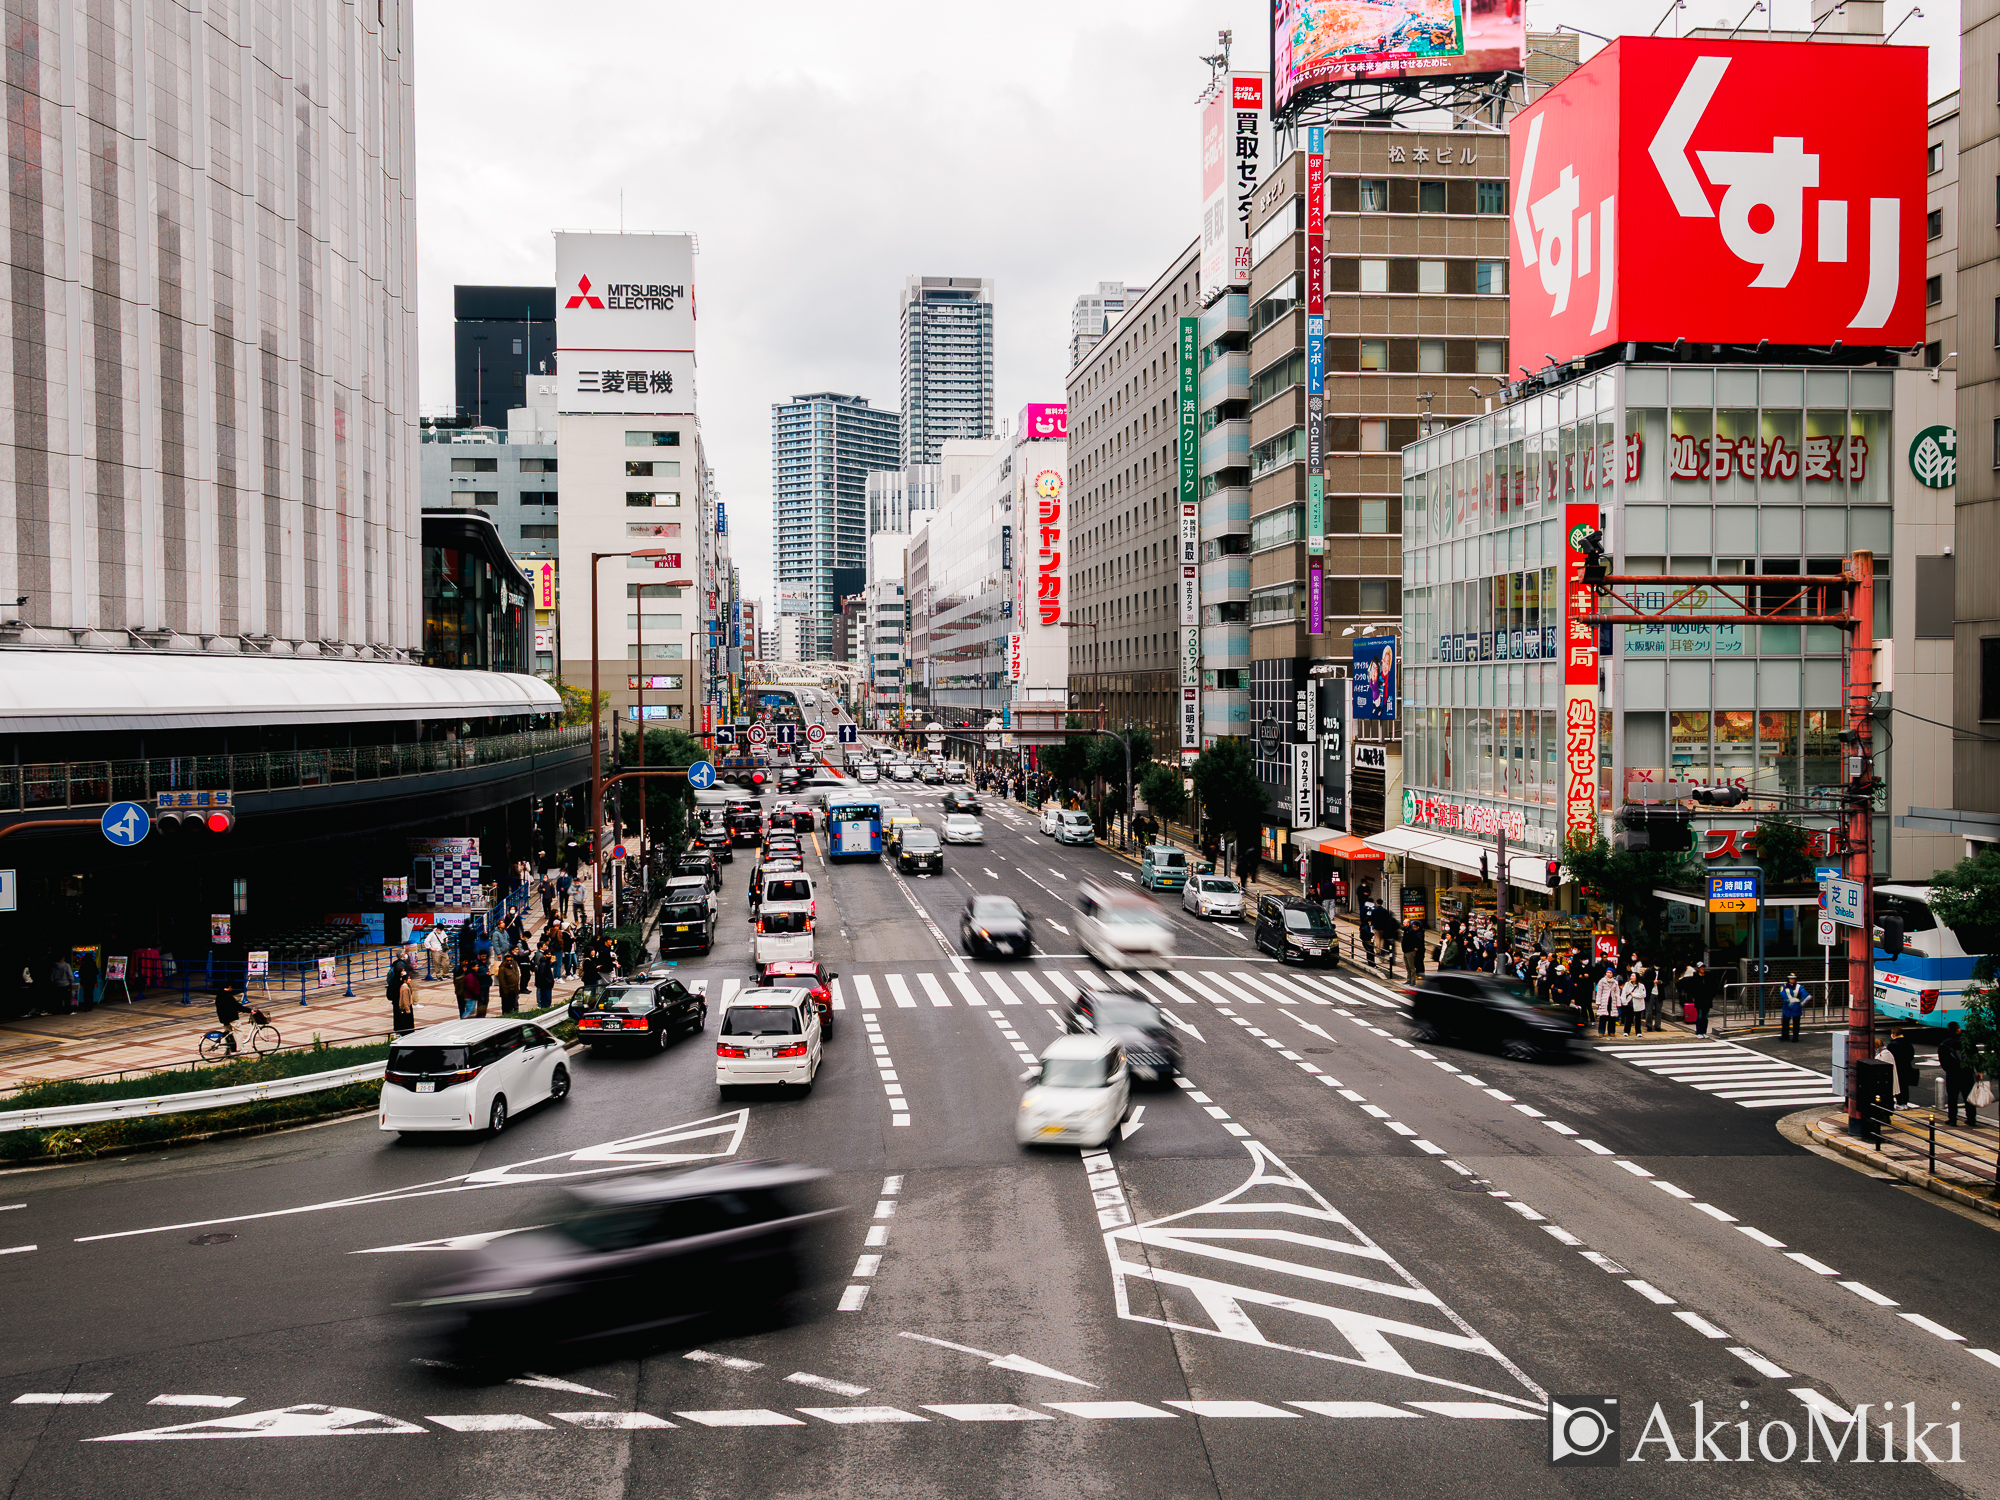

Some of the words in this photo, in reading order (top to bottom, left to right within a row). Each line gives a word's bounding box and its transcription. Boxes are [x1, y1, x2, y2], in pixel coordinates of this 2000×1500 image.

[1234, 92, 1261, 101] キタムラ
[1389, 145, 1477, 165] 松本ビル
[1236, 112, 1259, 240] 買取センター
[1648, 56, 1901, 329] くすり
[1260, 177, 1284, 213] 松本ビル
[1311, 170, 1321, 227] ボディスパ
[1203, 196, 1225, 252] 買取
[1513, 110, 1615, 337] くすり
[607, 284, 684, 298] MITSUBISHI
[1311, 245, 1321, 303] ヘッドスパ
[608, 297, 674, 310] ELECTRIC
[1184, 326, 1193, 360] 形成外科
[577, 370, 674, 394] 三菱電機
[1310, 340, 1322, 391] ラポート
[1182, 400, 1196, 493] 浜口クリニック
[1311, 412, 1322, 466] Z-CLINIC
[1670, 434, 1868, 482] 処方せん受付
[1038, 499, 1061, 626] ジャンカラ
[1184, 542, 1195, 561] 買取
[1570, 561, 1594, 667] ギ薬局
[1625, 590, 1664, 610] 守田
[1011, 634, 1021, 679] ジャンカラ
[1188, 628, 1197, 684] クロロフィル
[1441, 634, 1464, 661] 守田
[1185, 703, 1195, 745] 証明写真
[1296, 690, 1307, 732] 高価買取
[810, 730, 822, 738] 40
[1323, 732, 1340, 751] ナニワ
[1567, 698, 1596, 850] 処方せん受付
[159, 792, 230, 807] 時差信号
[1415, 795, 1460, 830] スギ薬局
[1463, 803, 1523, 842] 処方せん受付
[1725, 881, 1753, 891] 時間貸
[1831, 885, 1858, 907] 芝田
[407, 916, 427, 926] au
[1719, 901, 1734, 909] 入口
[1834, 906, 1855, 919] Shibata
[1596, 937, 1617, 956] くすり
